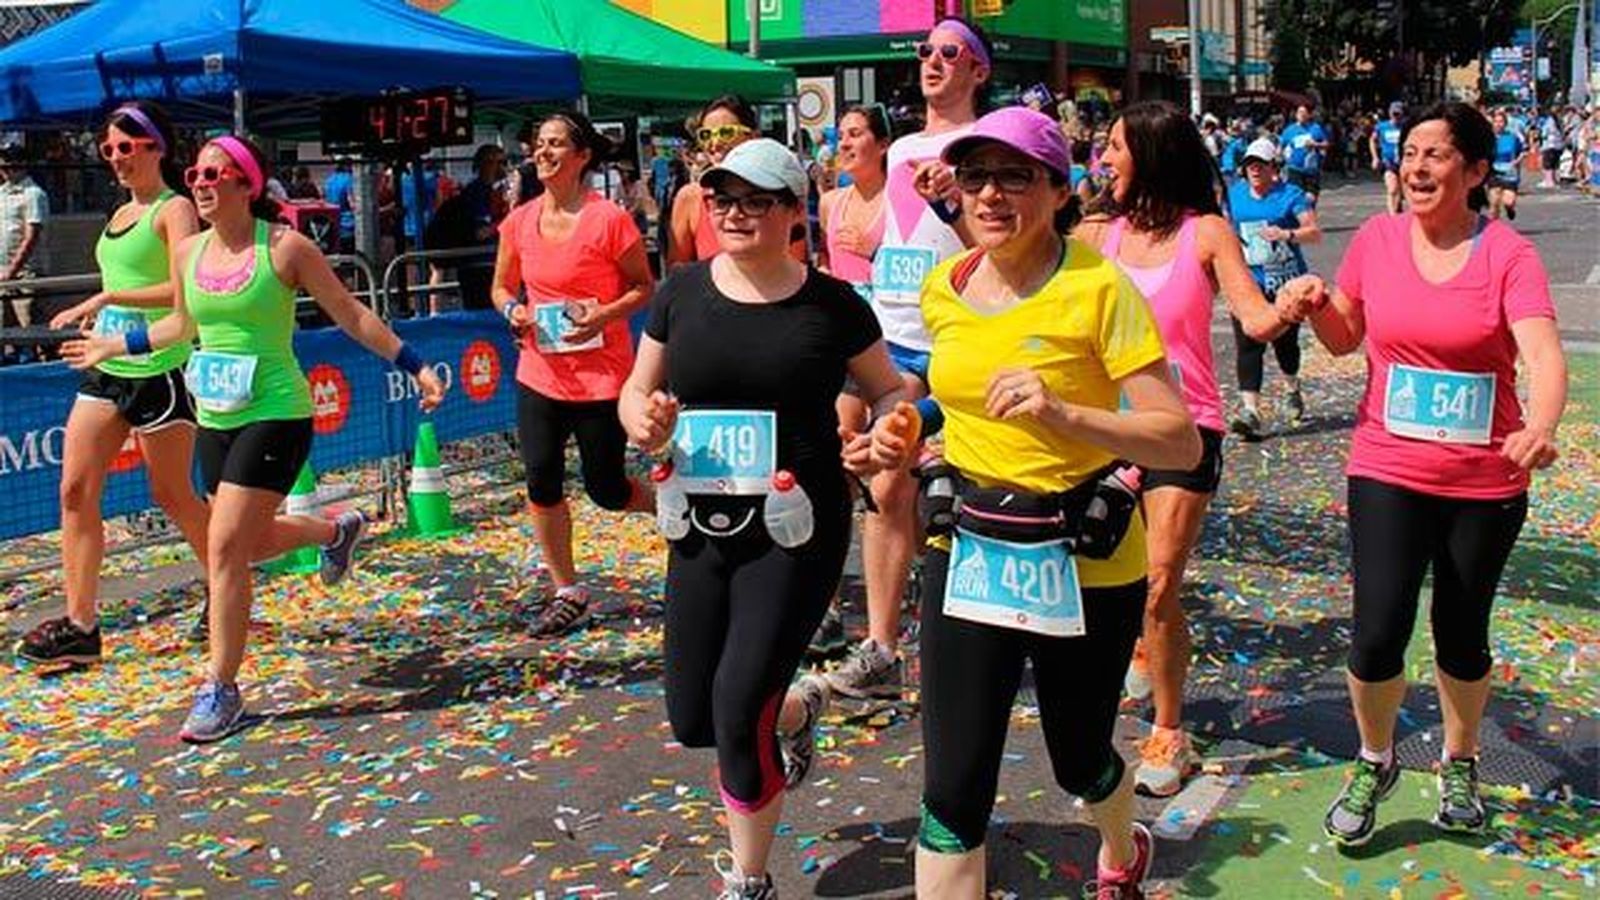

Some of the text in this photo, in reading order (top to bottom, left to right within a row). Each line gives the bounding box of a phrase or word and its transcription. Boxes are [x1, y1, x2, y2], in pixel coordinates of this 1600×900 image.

[889, 254, 924, 285] 539
[208, 359, 242, 394] 543
[1430, 381, 1480, 421] 541
[707, 423, 757, 469] 419
[953, 576, 989, 599] RUN
[1001, 554, 1063, 606] 420
